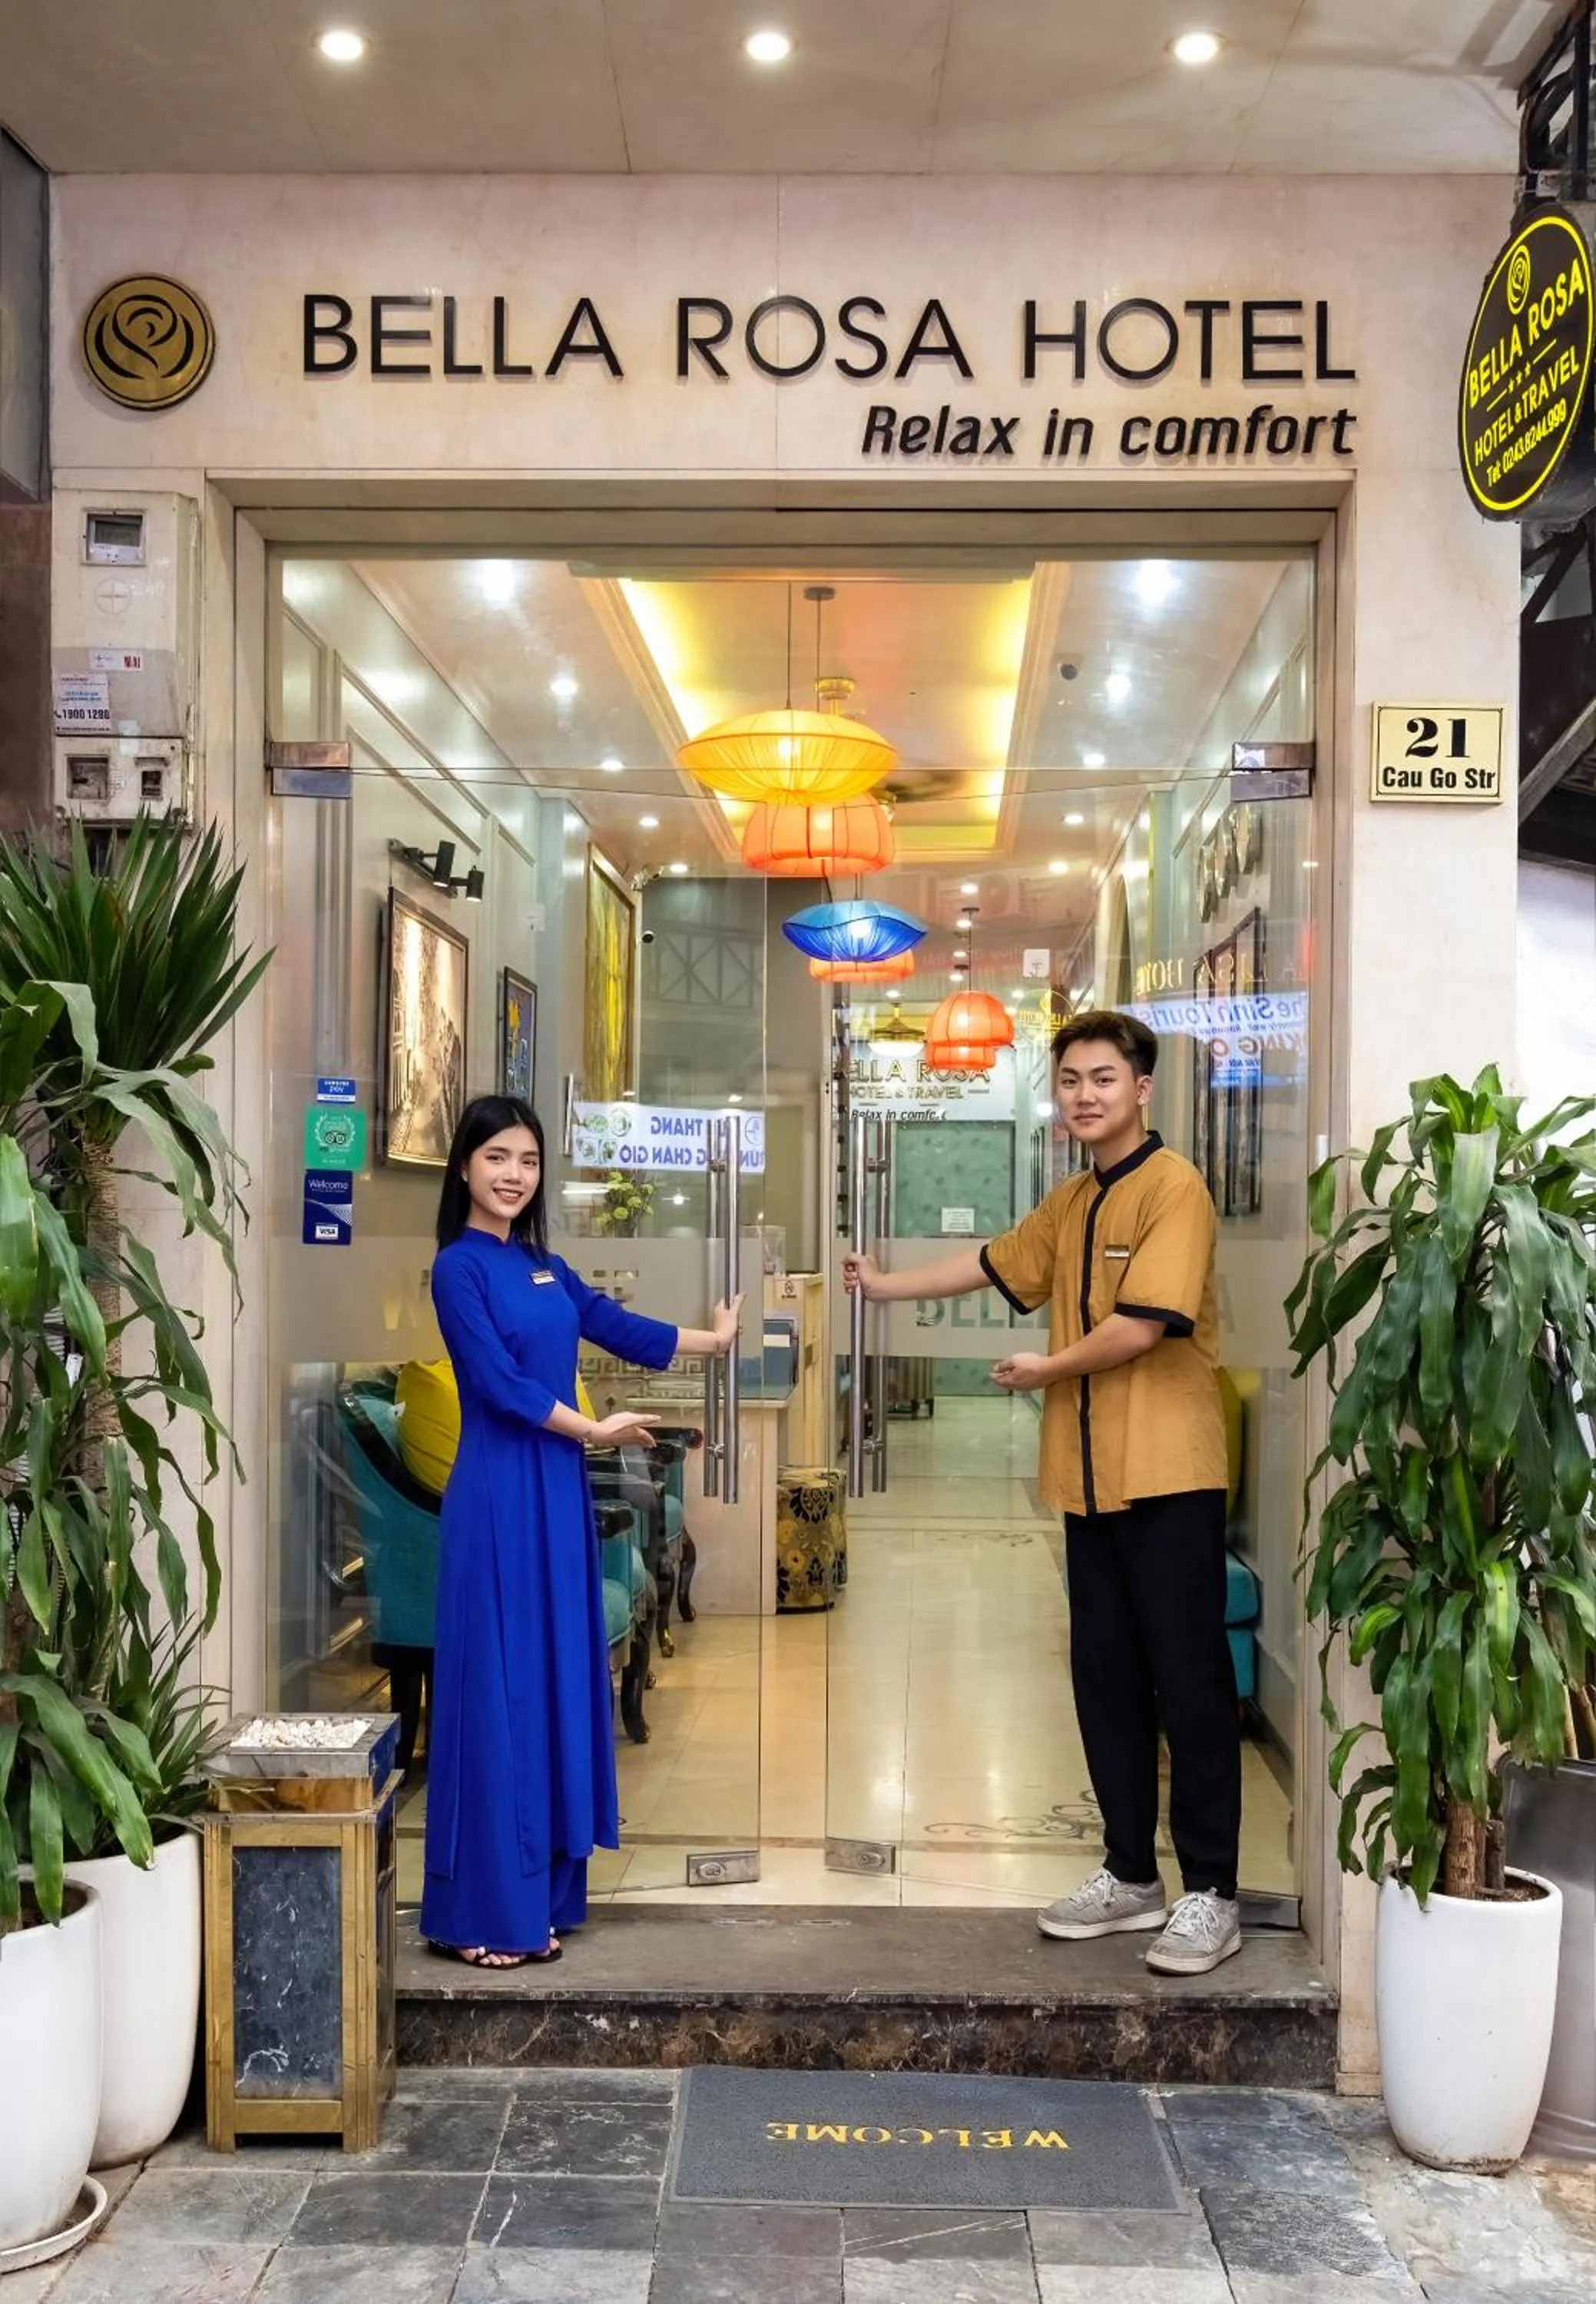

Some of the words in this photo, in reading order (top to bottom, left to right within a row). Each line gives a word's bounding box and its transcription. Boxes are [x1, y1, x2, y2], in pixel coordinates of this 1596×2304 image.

[303, 294, 624, 377] BELLA
[677, 295, 974, 379] ROSA
[1024, 297, 1356, 381] HOTEL
[1469, 323, 1524, 409] BELLA
[1528, 258, 1584, 346] ROSA
[862, 404, 1020, 456] Relax
[1043, 408, 1094, 455] in
[1120, 404, 1356, 455] comfort
[1474, 407, 1514, 467] HOTEL
[1521, 345, 1580, 419] TRAVEL
[1405, 717, 1471, 758] 21
[1382, 766, 1422, 788] Cau
[1430, 767, 1457, 788] Go
[1465, 767, 1495, 789] Str
[765, 2121, 1070, 2150] WELCOME
